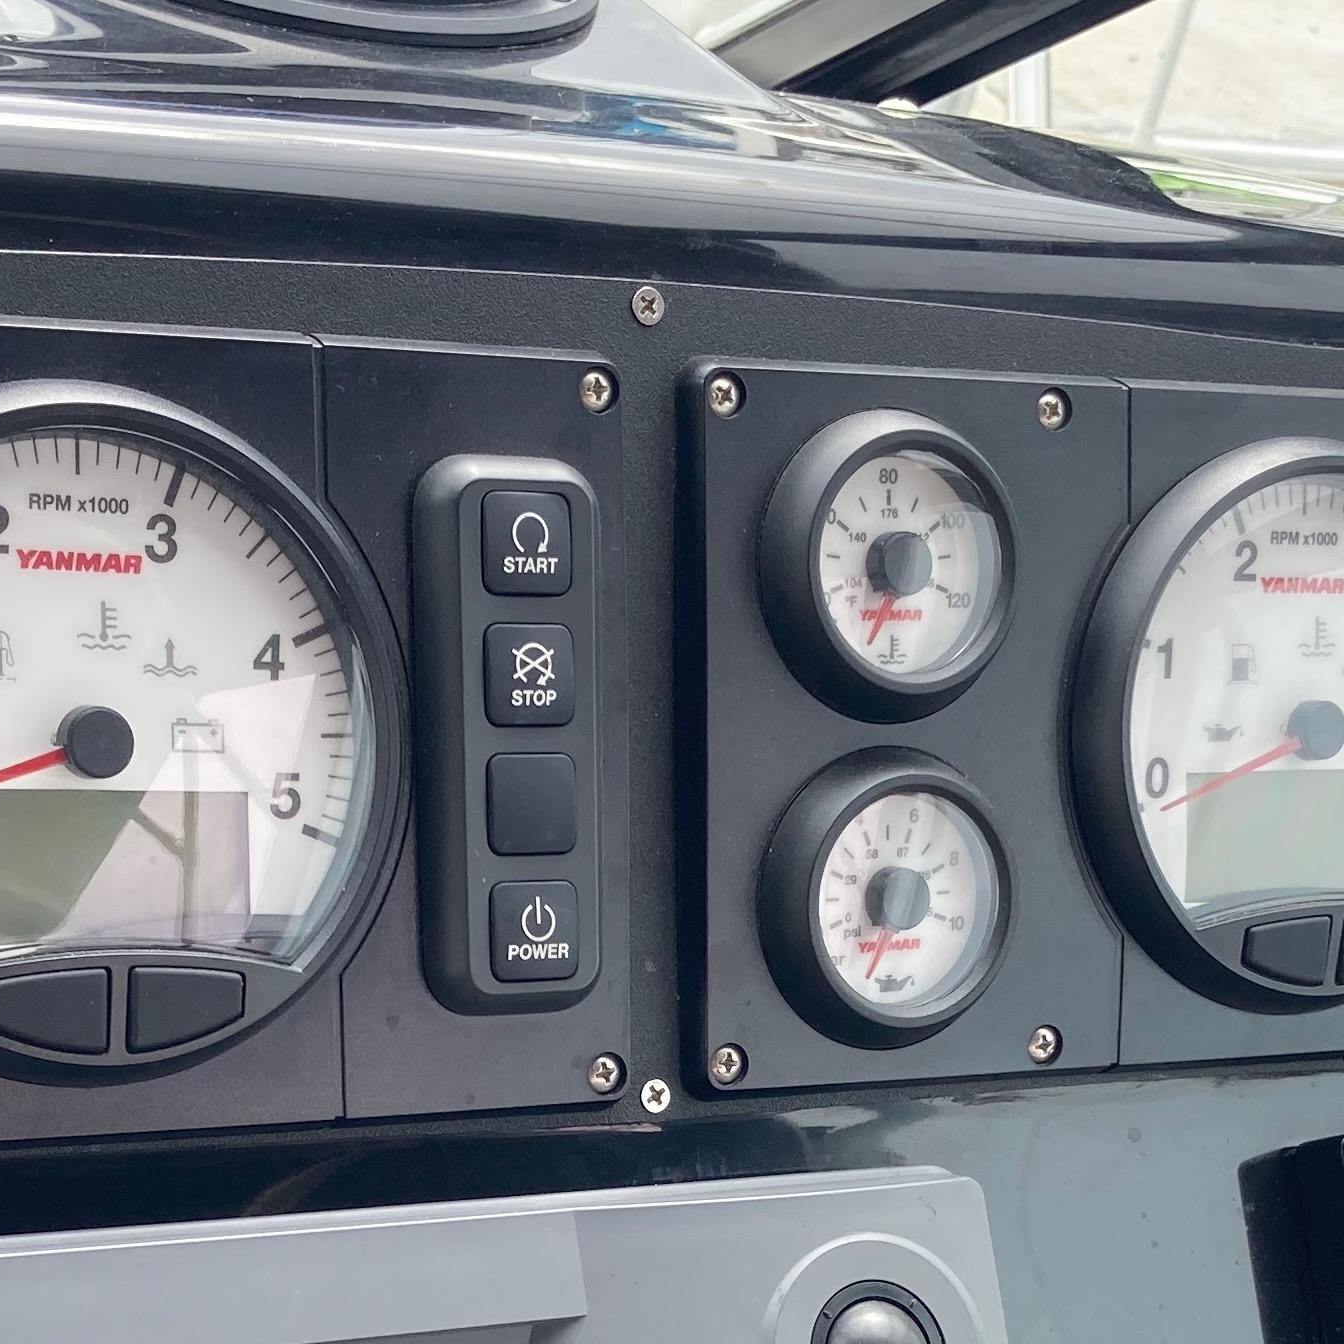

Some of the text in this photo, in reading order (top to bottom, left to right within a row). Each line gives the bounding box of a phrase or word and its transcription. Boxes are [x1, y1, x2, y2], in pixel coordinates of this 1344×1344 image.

[879, 468, 898, 484] 80
[28, 493, 129, 515] RPM x1000
[880, 509, 898, 519] 176
[940, 513, 965, 529] 100
[144, 514, 178, 564] 3
[848, 532, 866, 542] 140
[1270, 530, 1338, 547] RPM x1000
[15, 549, 143, 575] YANMAR
[503, 556, 558, 575] START
[1234, 540, 1257, 582] 2
[844, 578, 862, 588] 104
[946, 593, 970, 608] 120
[253, 634, 285, 681] 4
[1157, 637, 1174, 679] 1
[511, 689, 557, 706] STOP
[1145, 757, 1170, 799] 0
[270, 772, 301, 819] 5
[909, 808, 919, 823] 6
[866, 849, 878, 859] 58
[897, 848, 908, 857] 87
[949, 852, 958, 865] 8
[844, 875, 856, 885] 29
[845, 913, 851, 922] 0
[949, 916, 964, 930] 10
[844, 926, 861, 940] psi
[507, 943, 570, 961] POWER
